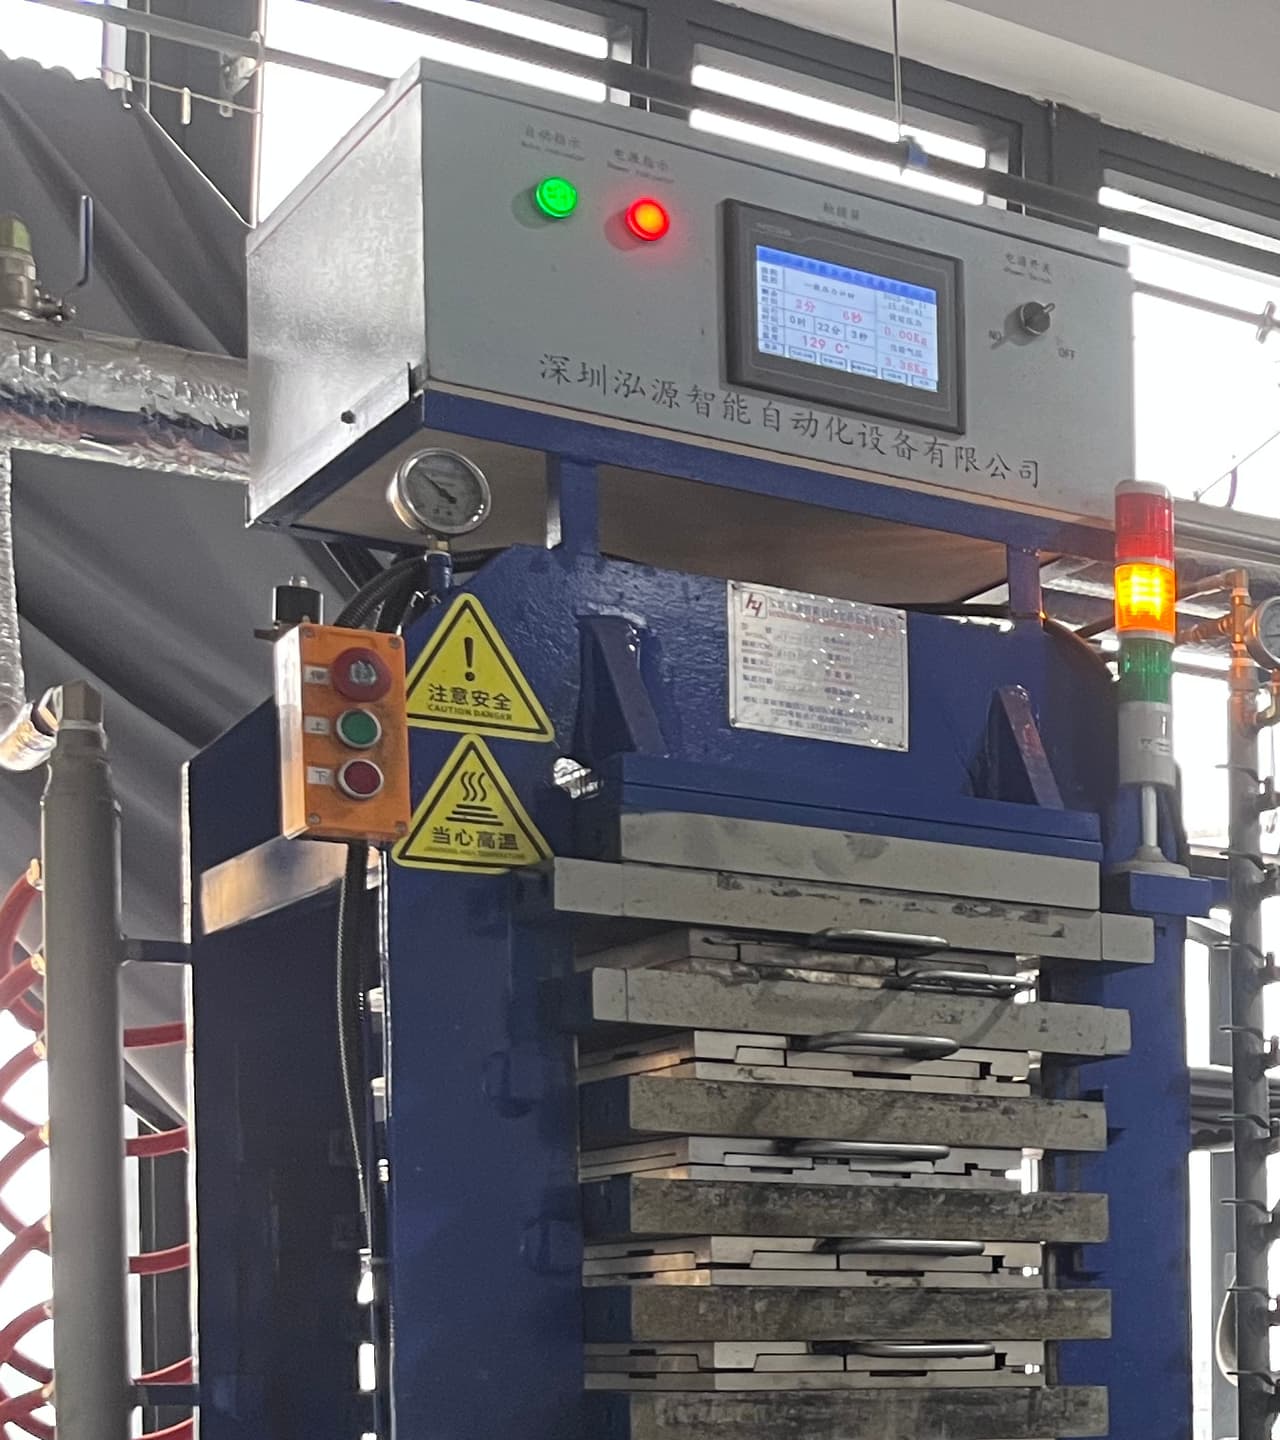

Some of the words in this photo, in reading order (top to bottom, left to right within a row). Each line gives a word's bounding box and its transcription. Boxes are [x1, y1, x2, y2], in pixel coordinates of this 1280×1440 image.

[539, 353, 1040, 488] 深圳泓源智能自动化设备有限公司
[428, 683, 512, 712] 注意安全
[428, 704, 473, 717] CAUTION
[474, 710, 513, 721] DANGER
[432, 826, 519, 851] 当心高温
